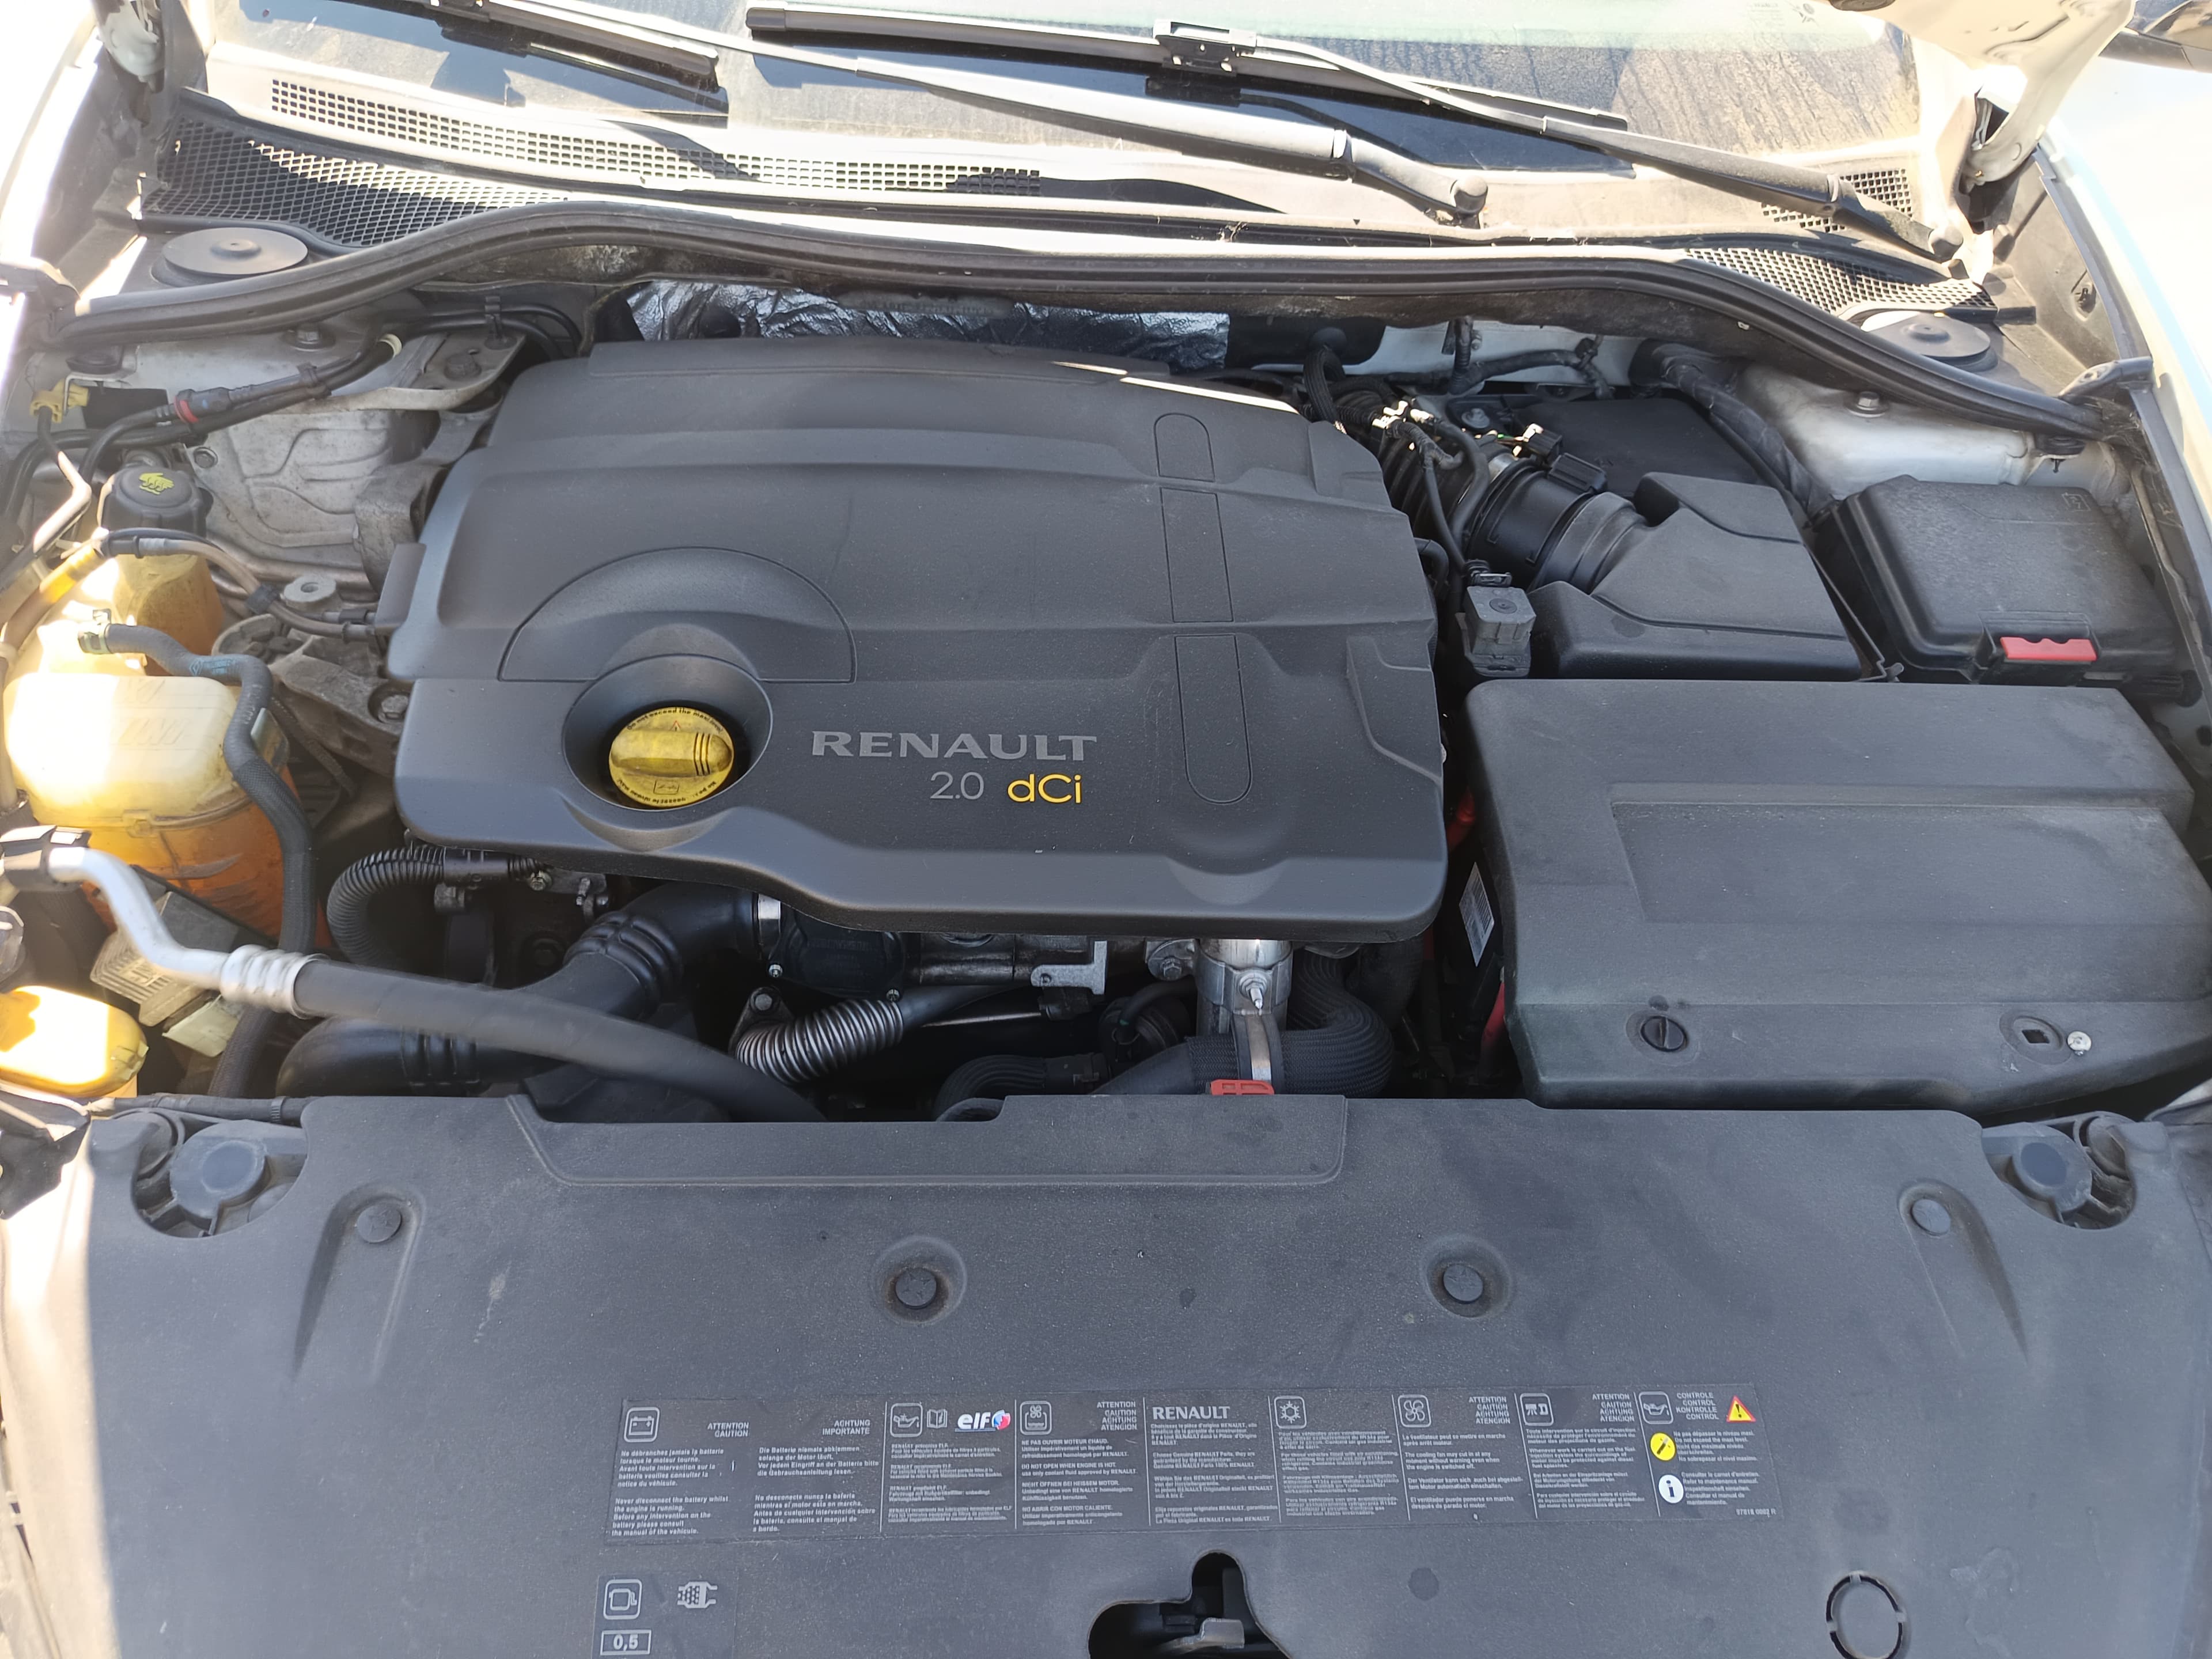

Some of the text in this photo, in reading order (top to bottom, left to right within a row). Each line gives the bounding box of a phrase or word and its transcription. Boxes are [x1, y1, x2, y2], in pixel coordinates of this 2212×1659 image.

[649, 709, 677, 717] exceed
[812, 730, 1097, 761] RENAULT
[930, 771, 1082, 804] 2.0 dCi
[957, 1411, 991, 1430] elf
[1152, 1406, 1230, 1420] RENAULT
[822, 1427, 870, 1435] IMPORTANTE
[613, 1634, 639, 1651] 0,5
